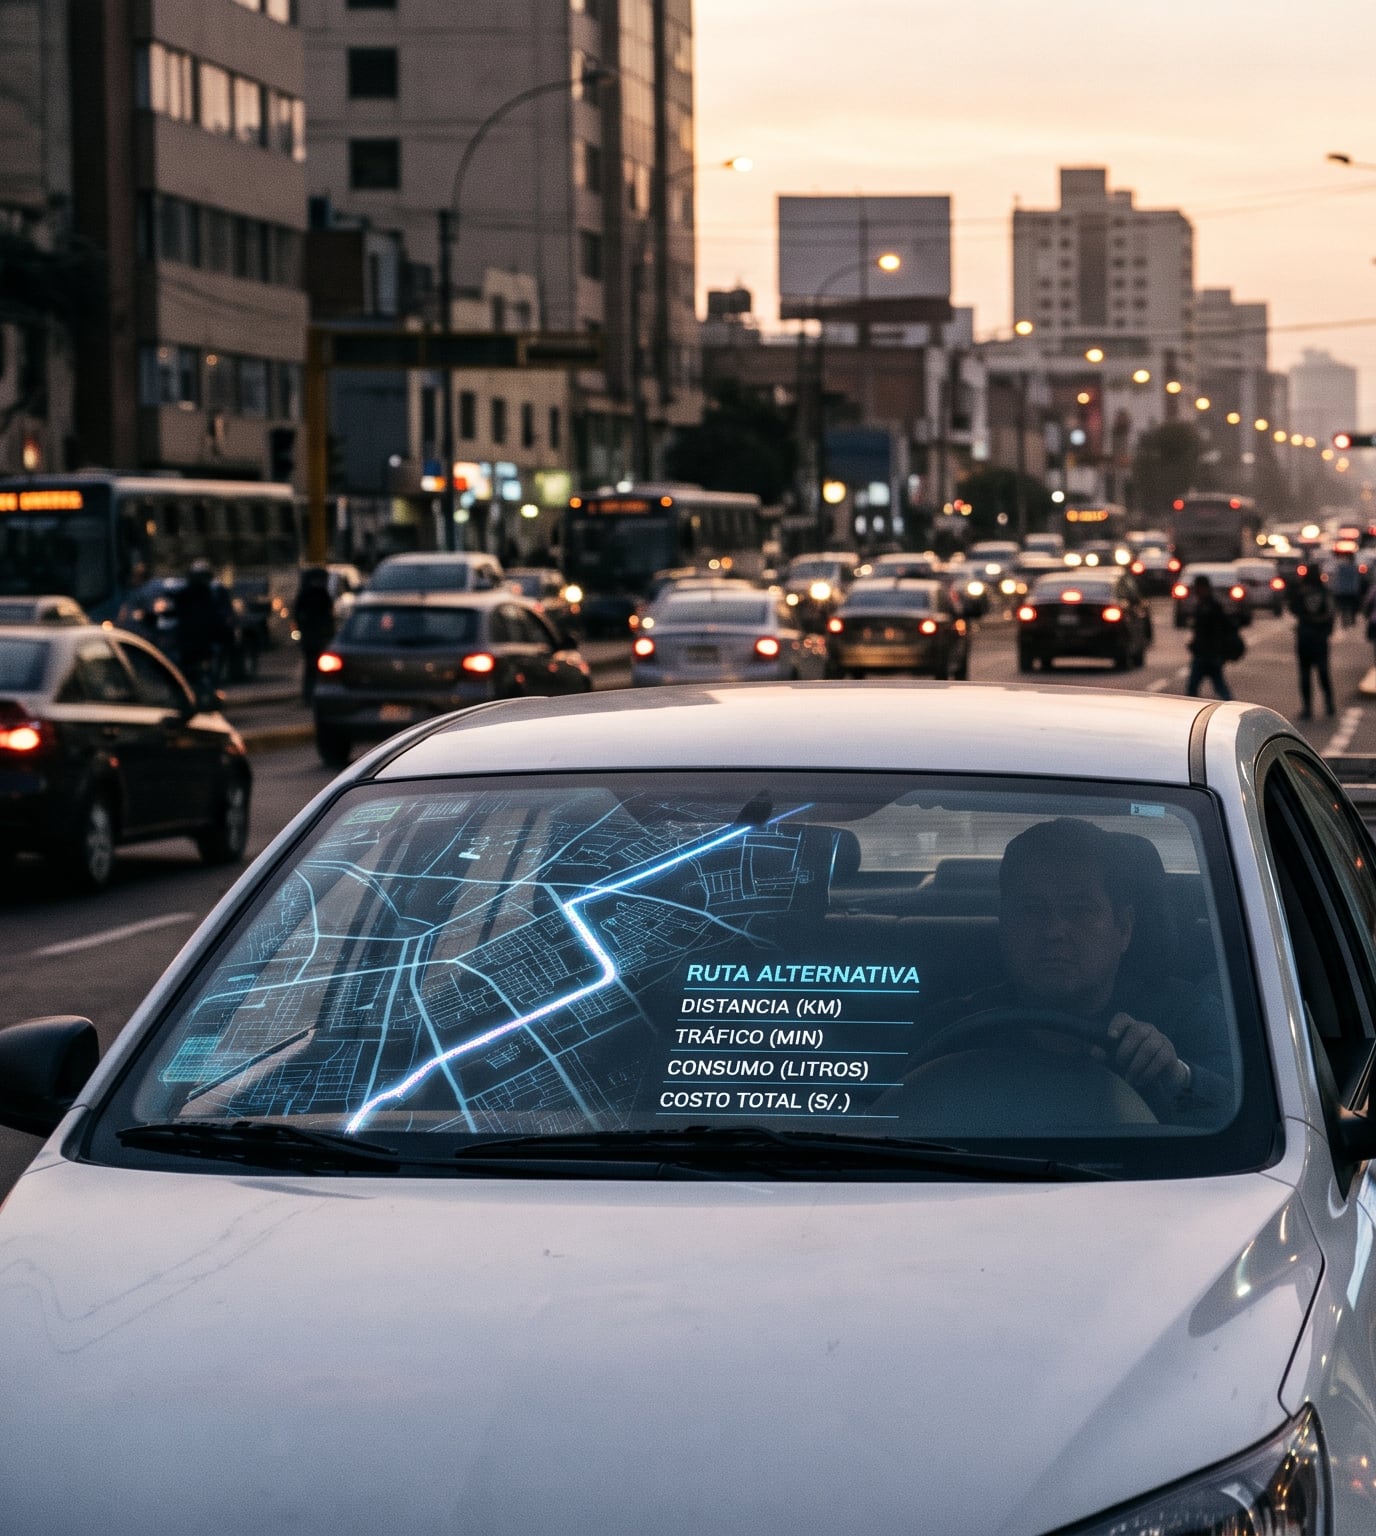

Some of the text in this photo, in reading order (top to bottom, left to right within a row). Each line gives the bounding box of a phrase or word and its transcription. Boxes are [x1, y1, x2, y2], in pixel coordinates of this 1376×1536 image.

[686, 964, 920, 984] RUTA ALTERNATIVA
[680, 998, 842, 1018] DISTANCIA (KM)
[675, 1026, 824, 1049] TRÁFICO (MIN)
[667, 1060, 869, 1081] CONSUMO (LITROS)
[659, 1091, 851, 1113] COSTO TOTAL (S/.)
